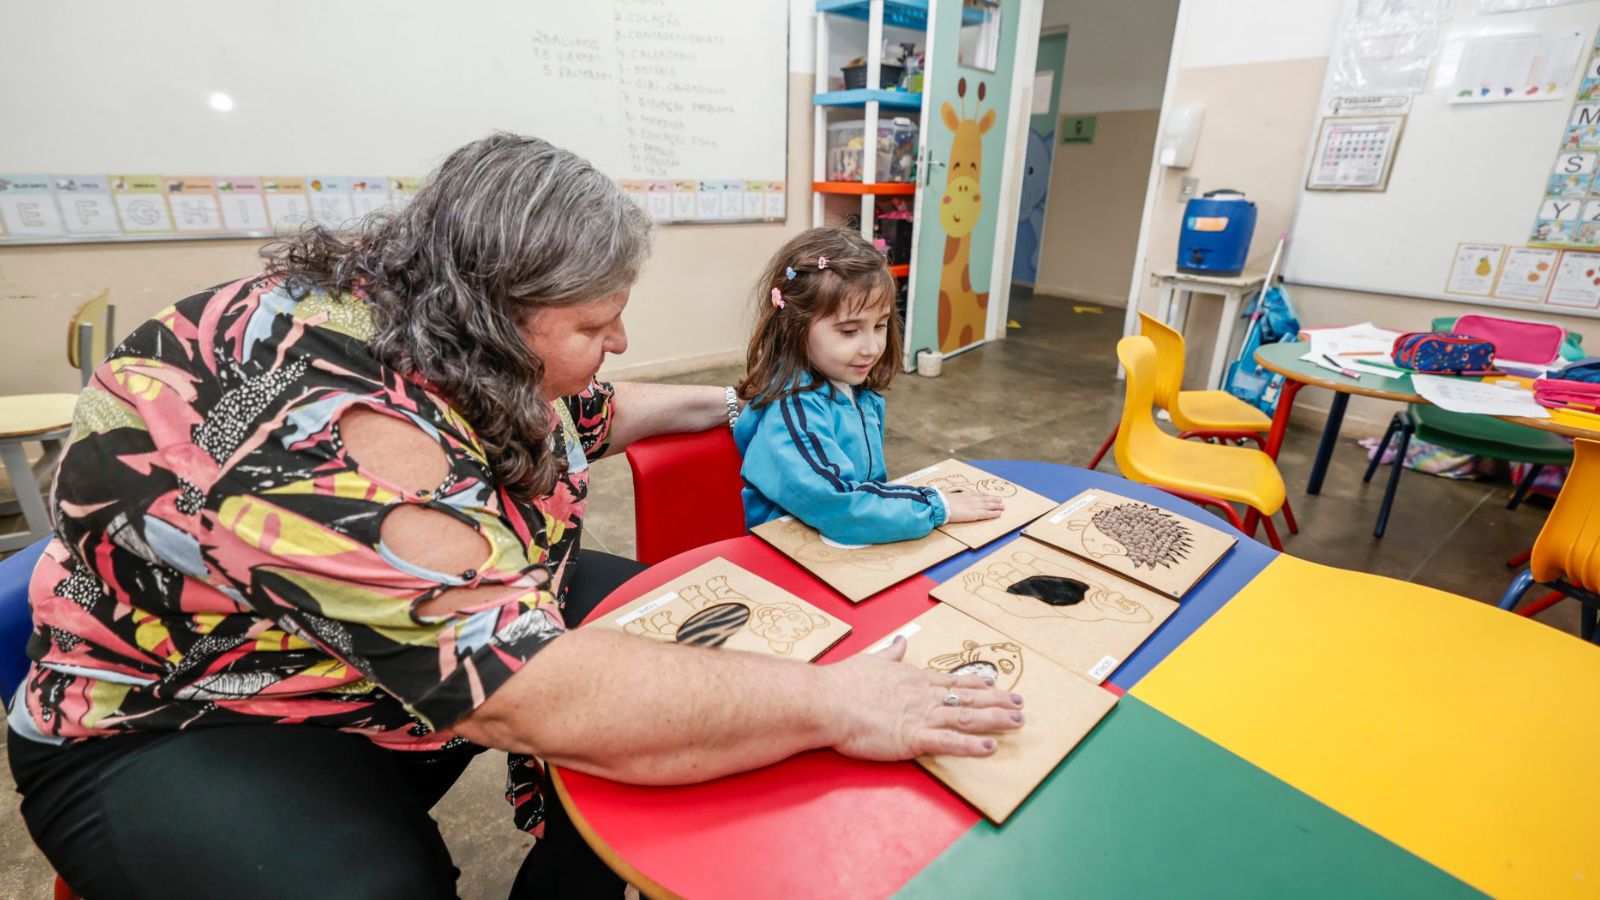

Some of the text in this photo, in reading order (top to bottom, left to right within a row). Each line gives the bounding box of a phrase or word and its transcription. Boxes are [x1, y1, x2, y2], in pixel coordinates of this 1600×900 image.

[1578, 107, 1600, 125] M
[1564, 156, 1585, 173] S
[16, 202, 46, 227] E
[75, 200, 99, 226] F
[127, 199, 161, 226] G
[180, 200, 209, 225] H
[1553, 202, 1571, 219] Y
